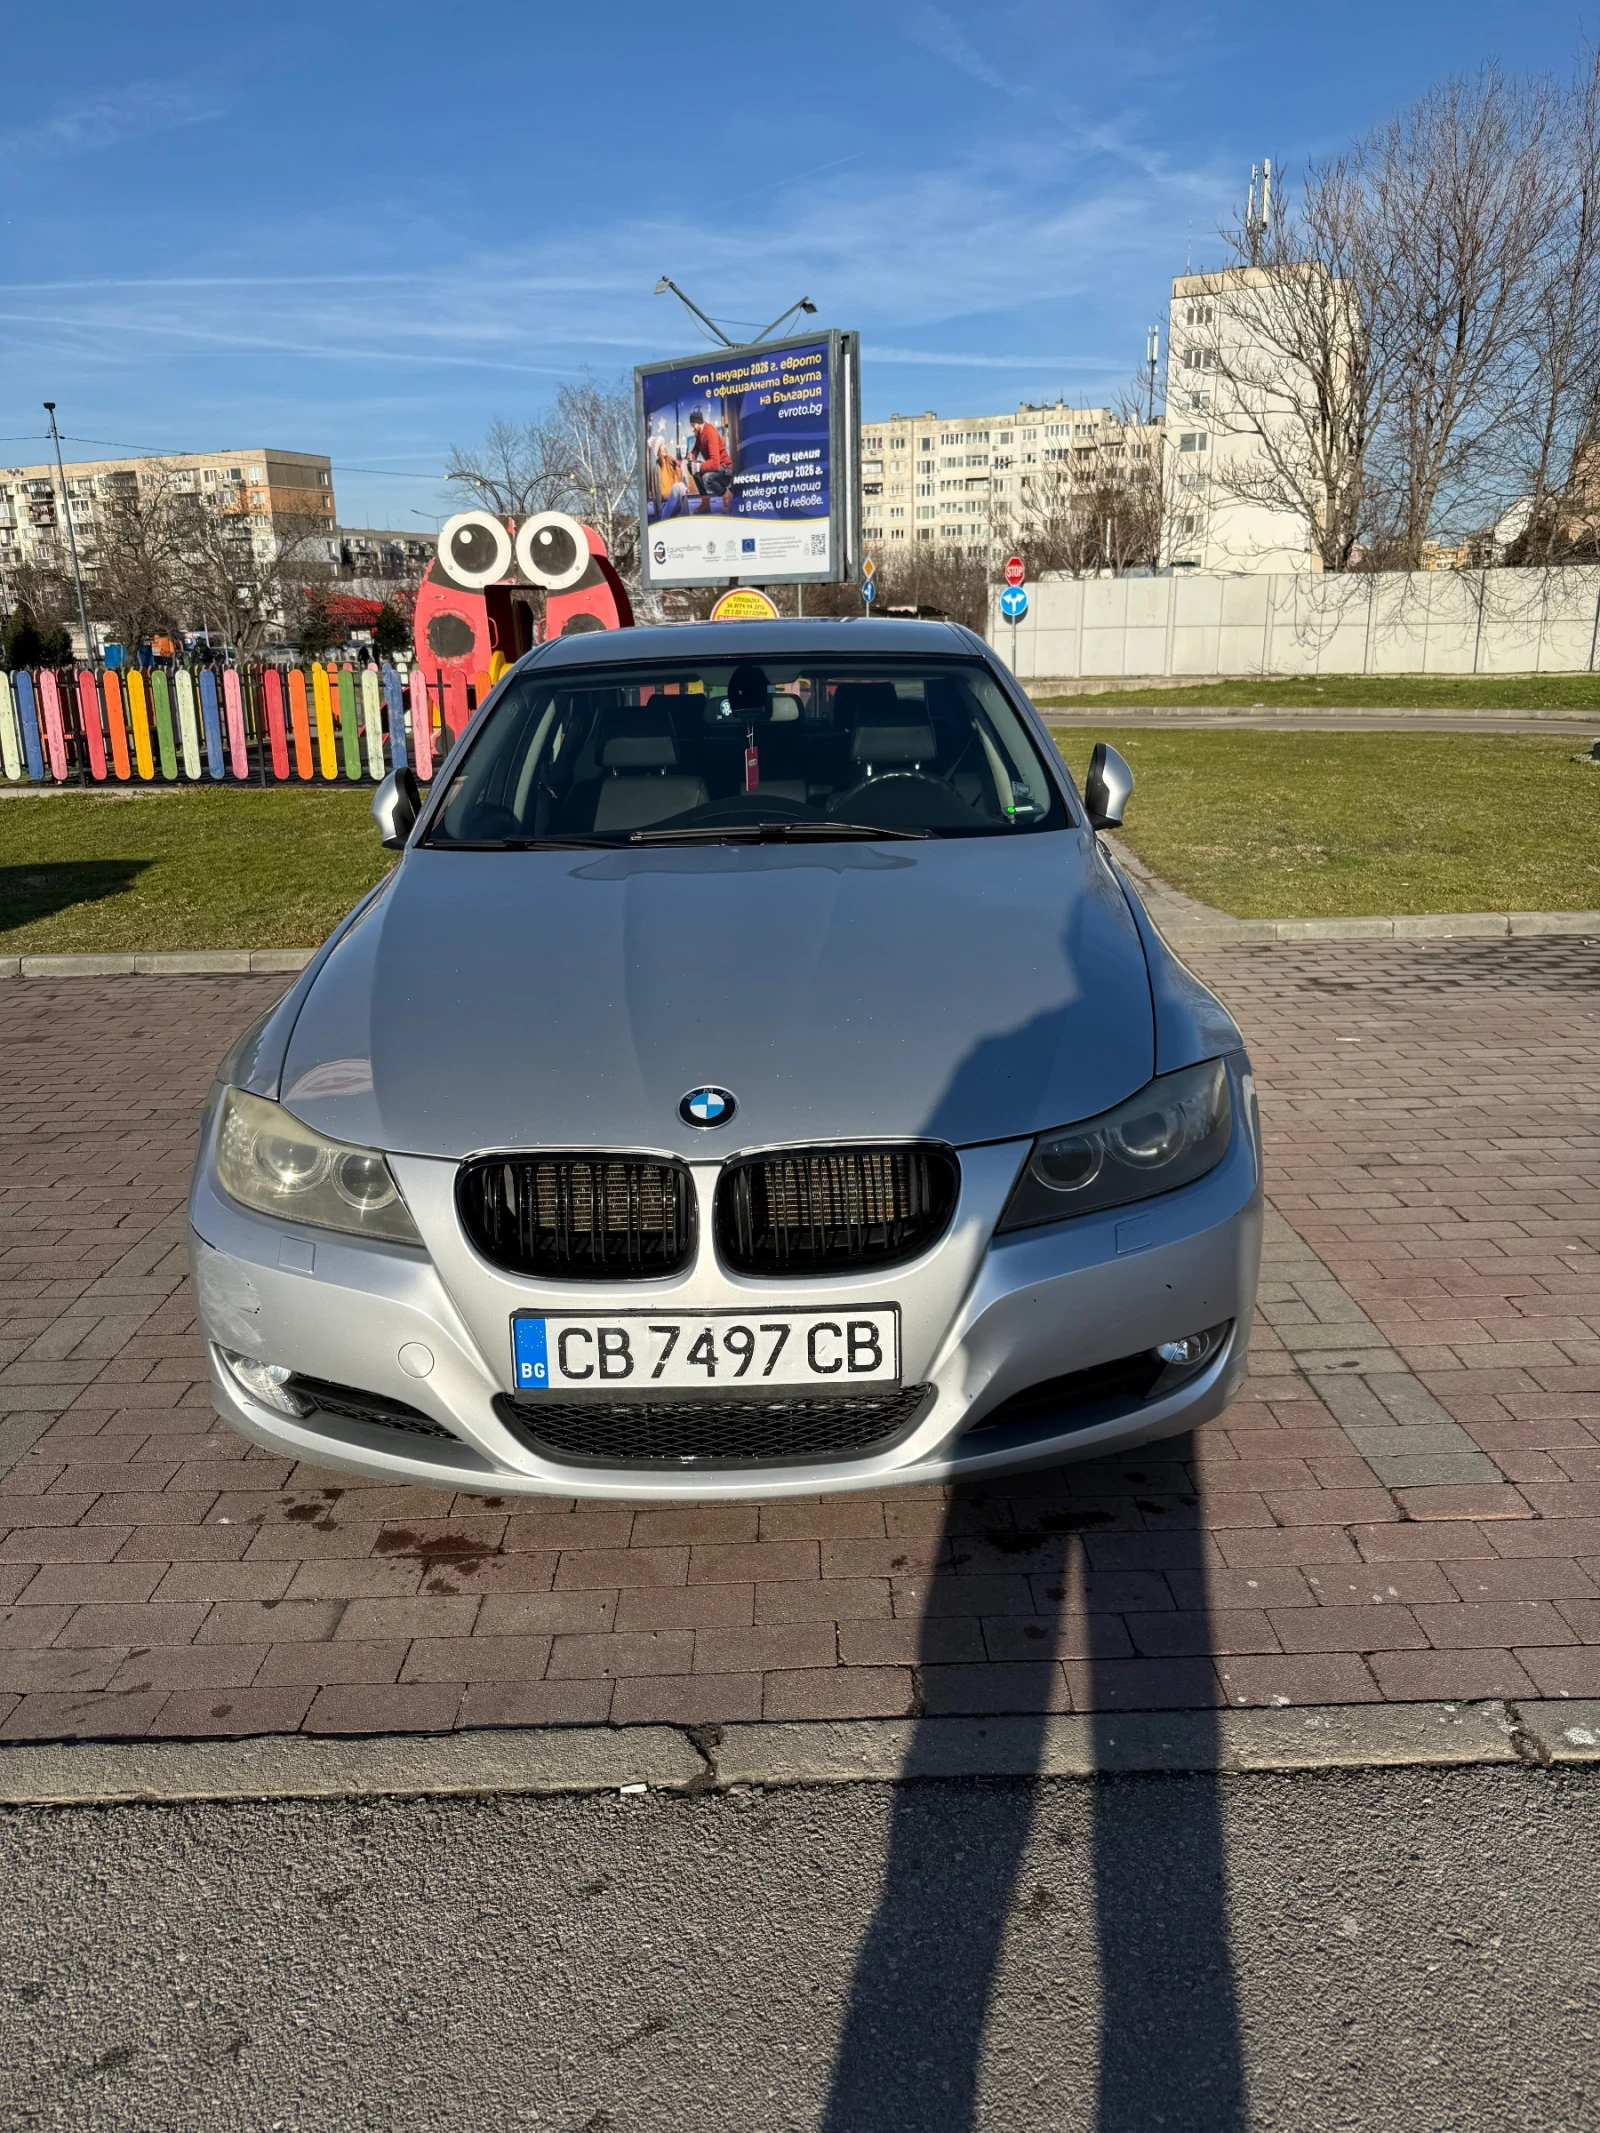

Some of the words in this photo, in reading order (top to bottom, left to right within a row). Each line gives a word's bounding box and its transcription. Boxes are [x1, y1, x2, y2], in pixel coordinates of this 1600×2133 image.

[692, 374, 708, 385] От
[710, 372, 714, 382] 1
[716, 366, 749, 382] януари
[751, 361, 768, 376] 2026
[770, 363, 778, 372] г.
[780, 353, 822, 370] еврото
[705, 389, 711, 398] е
[713, 378, 780, 398] официалната
[782, 370, 822, 385] валута
[759, 395, 771, 406] на
[773, 386, 822, 404] България
[778, 402, 823, 419] evroto.bg
[768, 452, 790, 465] През
[792, 449, 820, 461] целия
[733, 473, 760, 485] месец
[761, 469, 794, 483] януари
[795, 464, 814, 477] 2026
[815, 467, 823, 475] г.
[742, 486, 765, 498] може
[765, 487, 777, 498] да
[778, 484, 789, 494] се
[790, 481, 821, 493] плаща
[738, 504, 745, 513] и
[745, 501, 751, 512] в
[752, 500, 774, 512] евро,
[775, 500, 782, 509] и
[783, 497, 789, 508] в
[790, 494, 824, 508] левове.
[1007, 566, 1023, 577] STOP
[685, 1087, 732, 1100] BMW
[557, 1326, 635, 1380] CB
[648, 1323, 792, 1379] 7497
[807, 1320, 883, 1374] CB
[520, 1362, 546, 1379] BG
